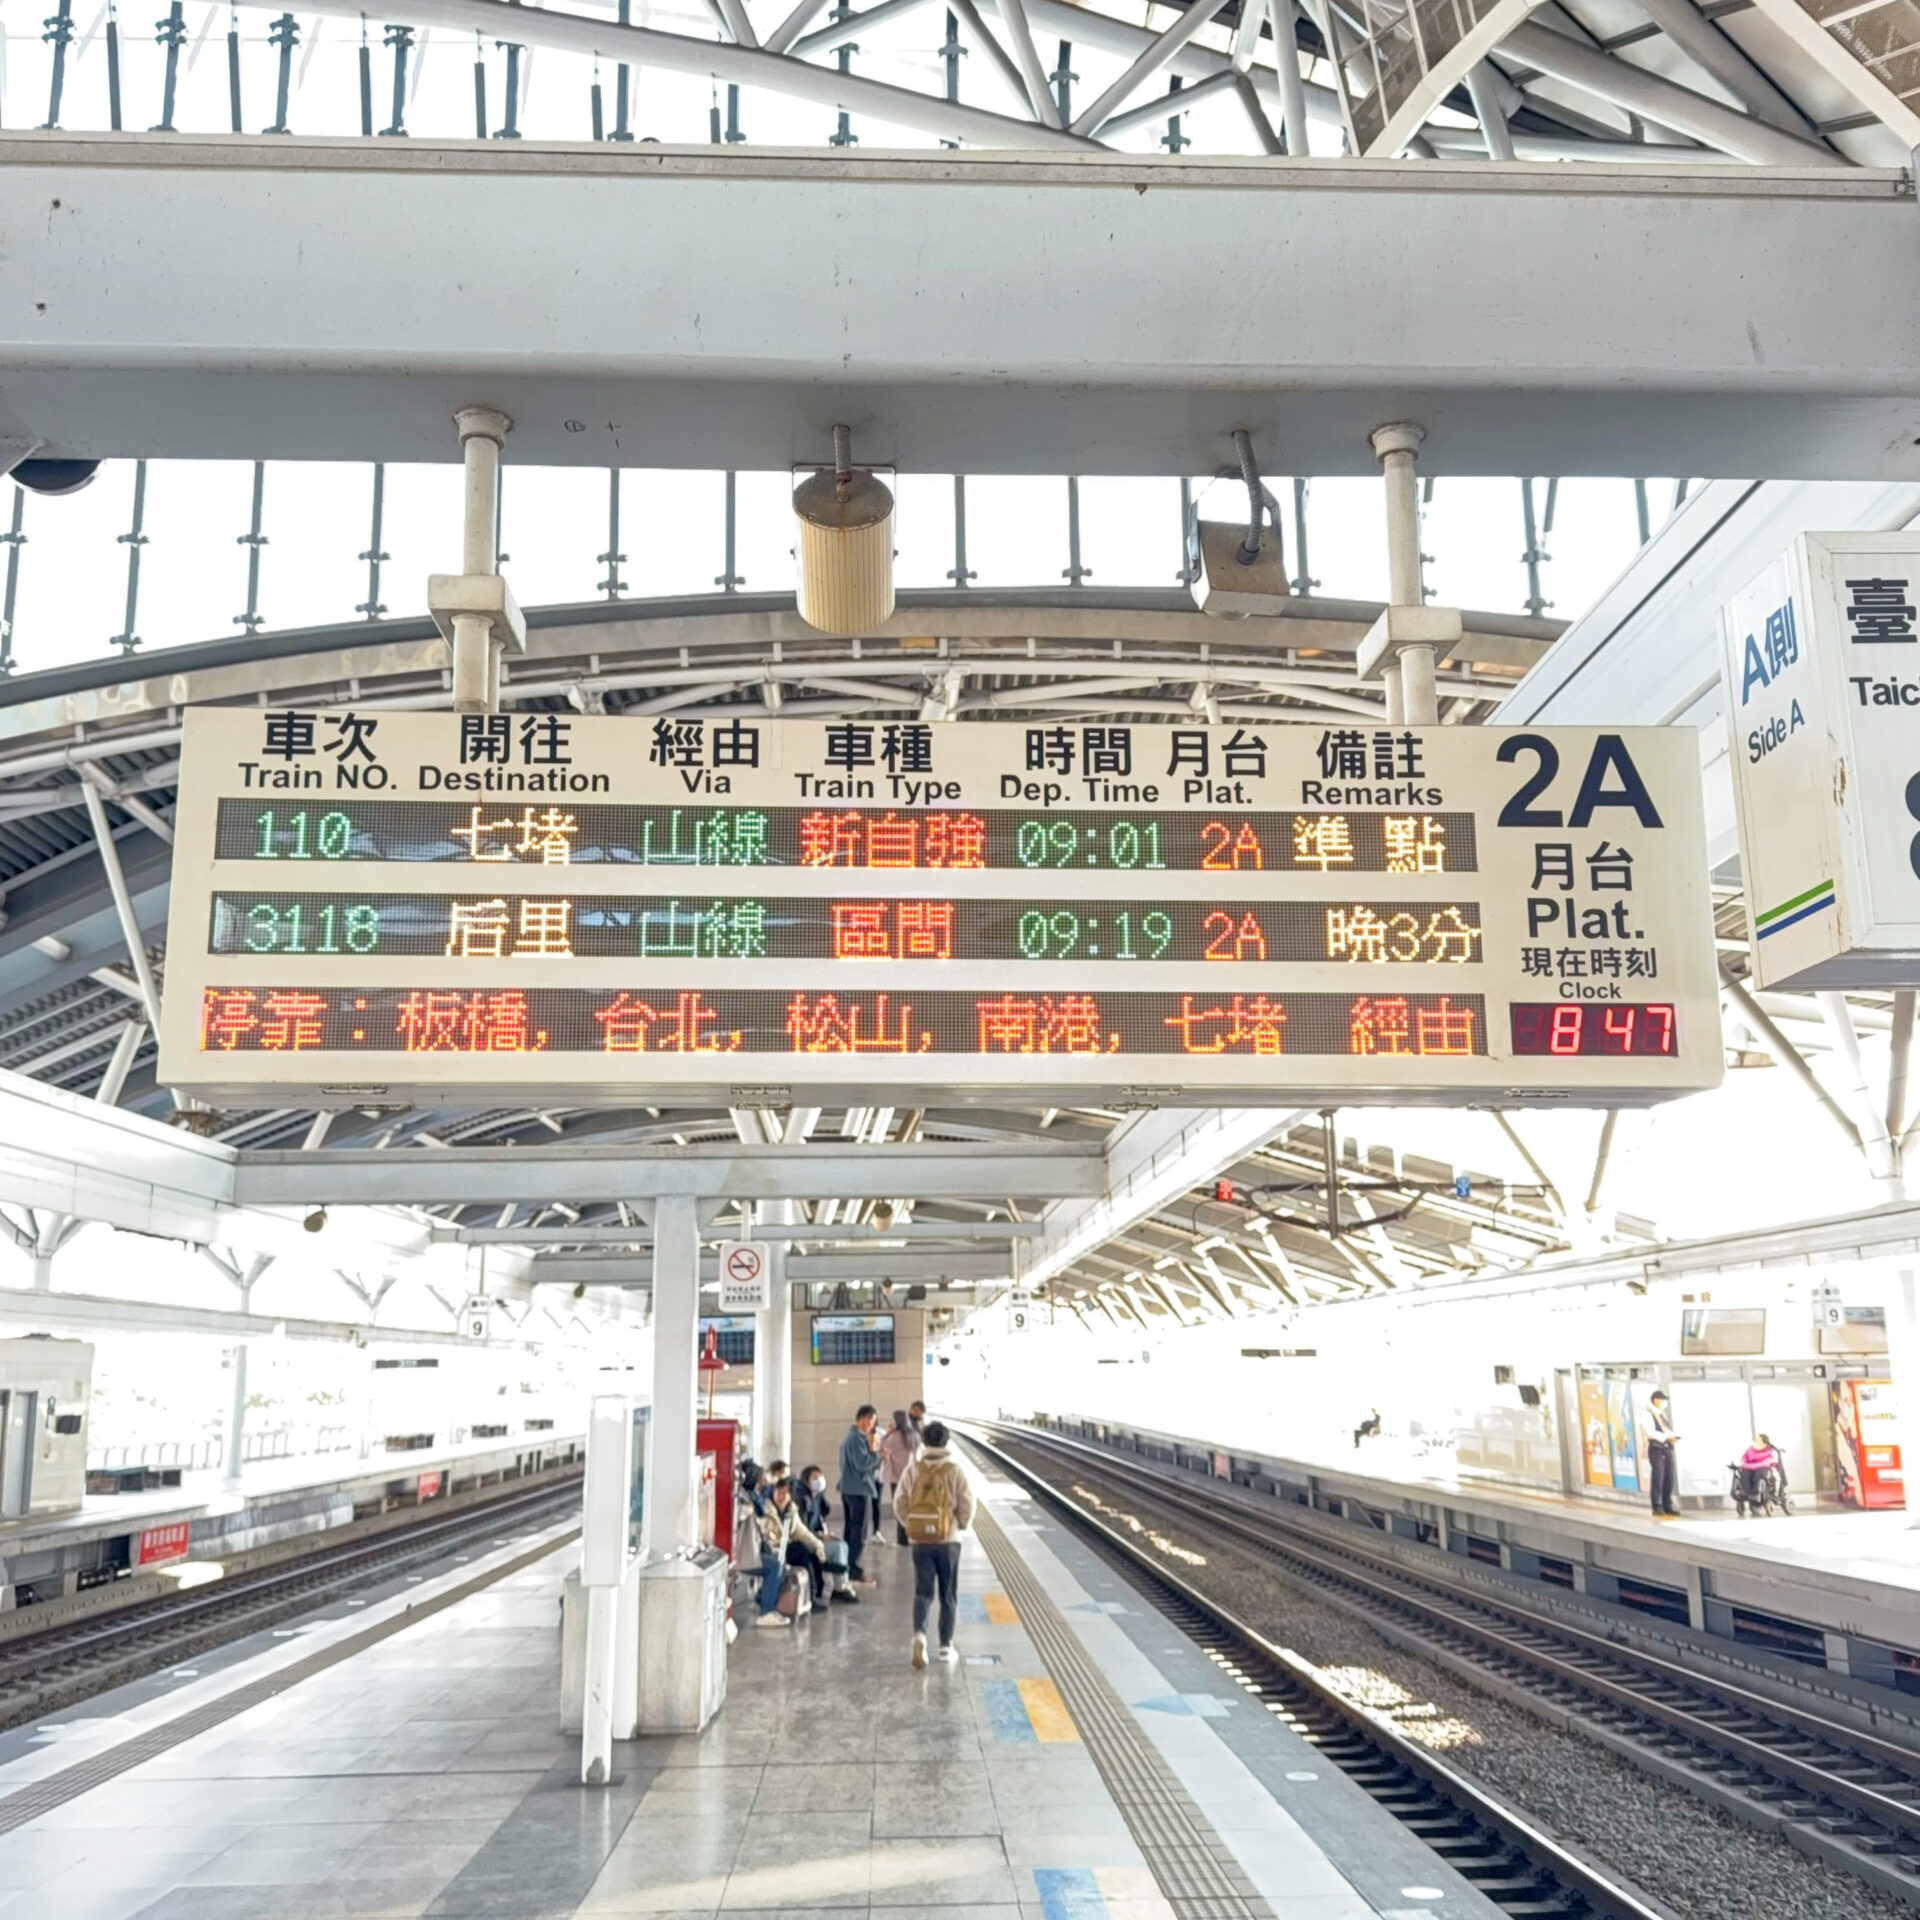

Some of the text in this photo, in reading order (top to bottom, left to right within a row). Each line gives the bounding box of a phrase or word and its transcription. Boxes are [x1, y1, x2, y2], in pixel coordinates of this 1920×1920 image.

[1845, 578, 1918, 643] 臺
[1742, 595, 1798, 706] A側
[1849, 676, 1920, 706] Taic
[262, 711, 1426, 780] 車次 開往 經由 車種 時間 月台 備註
[1748, 697, 1805, 764] Side A
[238, 763, 397, 790] Train NO.
[419, 765, 610, 792] Destination
[681, 770, 731, 793] Via
[795, 773, 961, 805] Train Type
[1000, 775, 1160, 807] Dep. Time
[1184, 780, 1253, 804] Plat.
[1496, 733, 1665, 828] 2A
[1302, 781, 1443, 806] Remarks
[256, 811, 350, 858] 110
[450, 807, 578, 866] 七堵
[643, 810, 768, 866] 山線
[801, 811, 986, 869] 新自強
[1018, 821, 1166, 868] 09:01
[1200, 822, 1262, 870] 2A
[1531, 841, 1634, 891] 月台
[246, 899, 1482, 963] 3118 后里 山線 區間 09:19 2A 晚3分
[1527, 897, 1645, 939] Plat.
[1521, 947, 1657, 979] 現在時刻
[1558, 981, 1622, 999] Clock
[473, 1321, 482, 1336] 9
[1015, 1313, 1024, 1328] 9
[1829, 1308, 1838, 1323] 9
